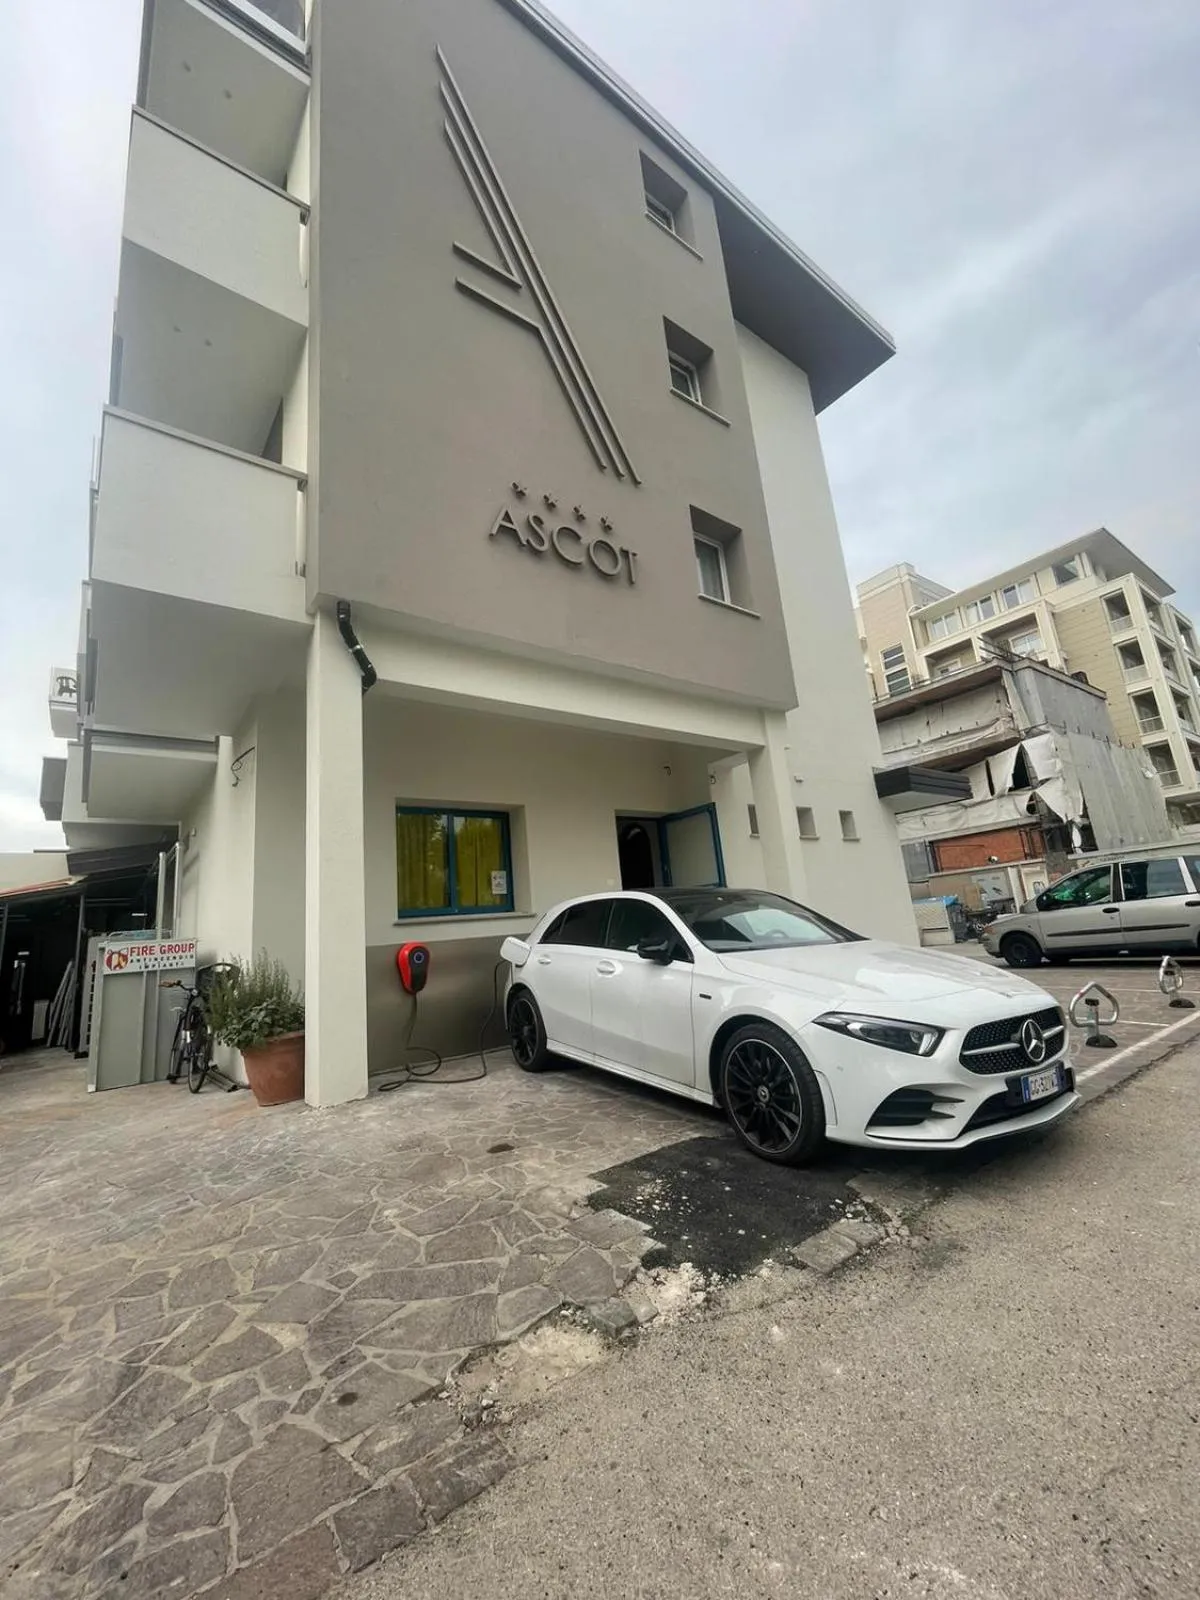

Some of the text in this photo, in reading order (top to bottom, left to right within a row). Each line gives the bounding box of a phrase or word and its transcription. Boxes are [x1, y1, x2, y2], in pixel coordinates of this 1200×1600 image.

[488, 505, 638, 585] ASCOT
[130, 943, 195, 956] FIRE GROUP
